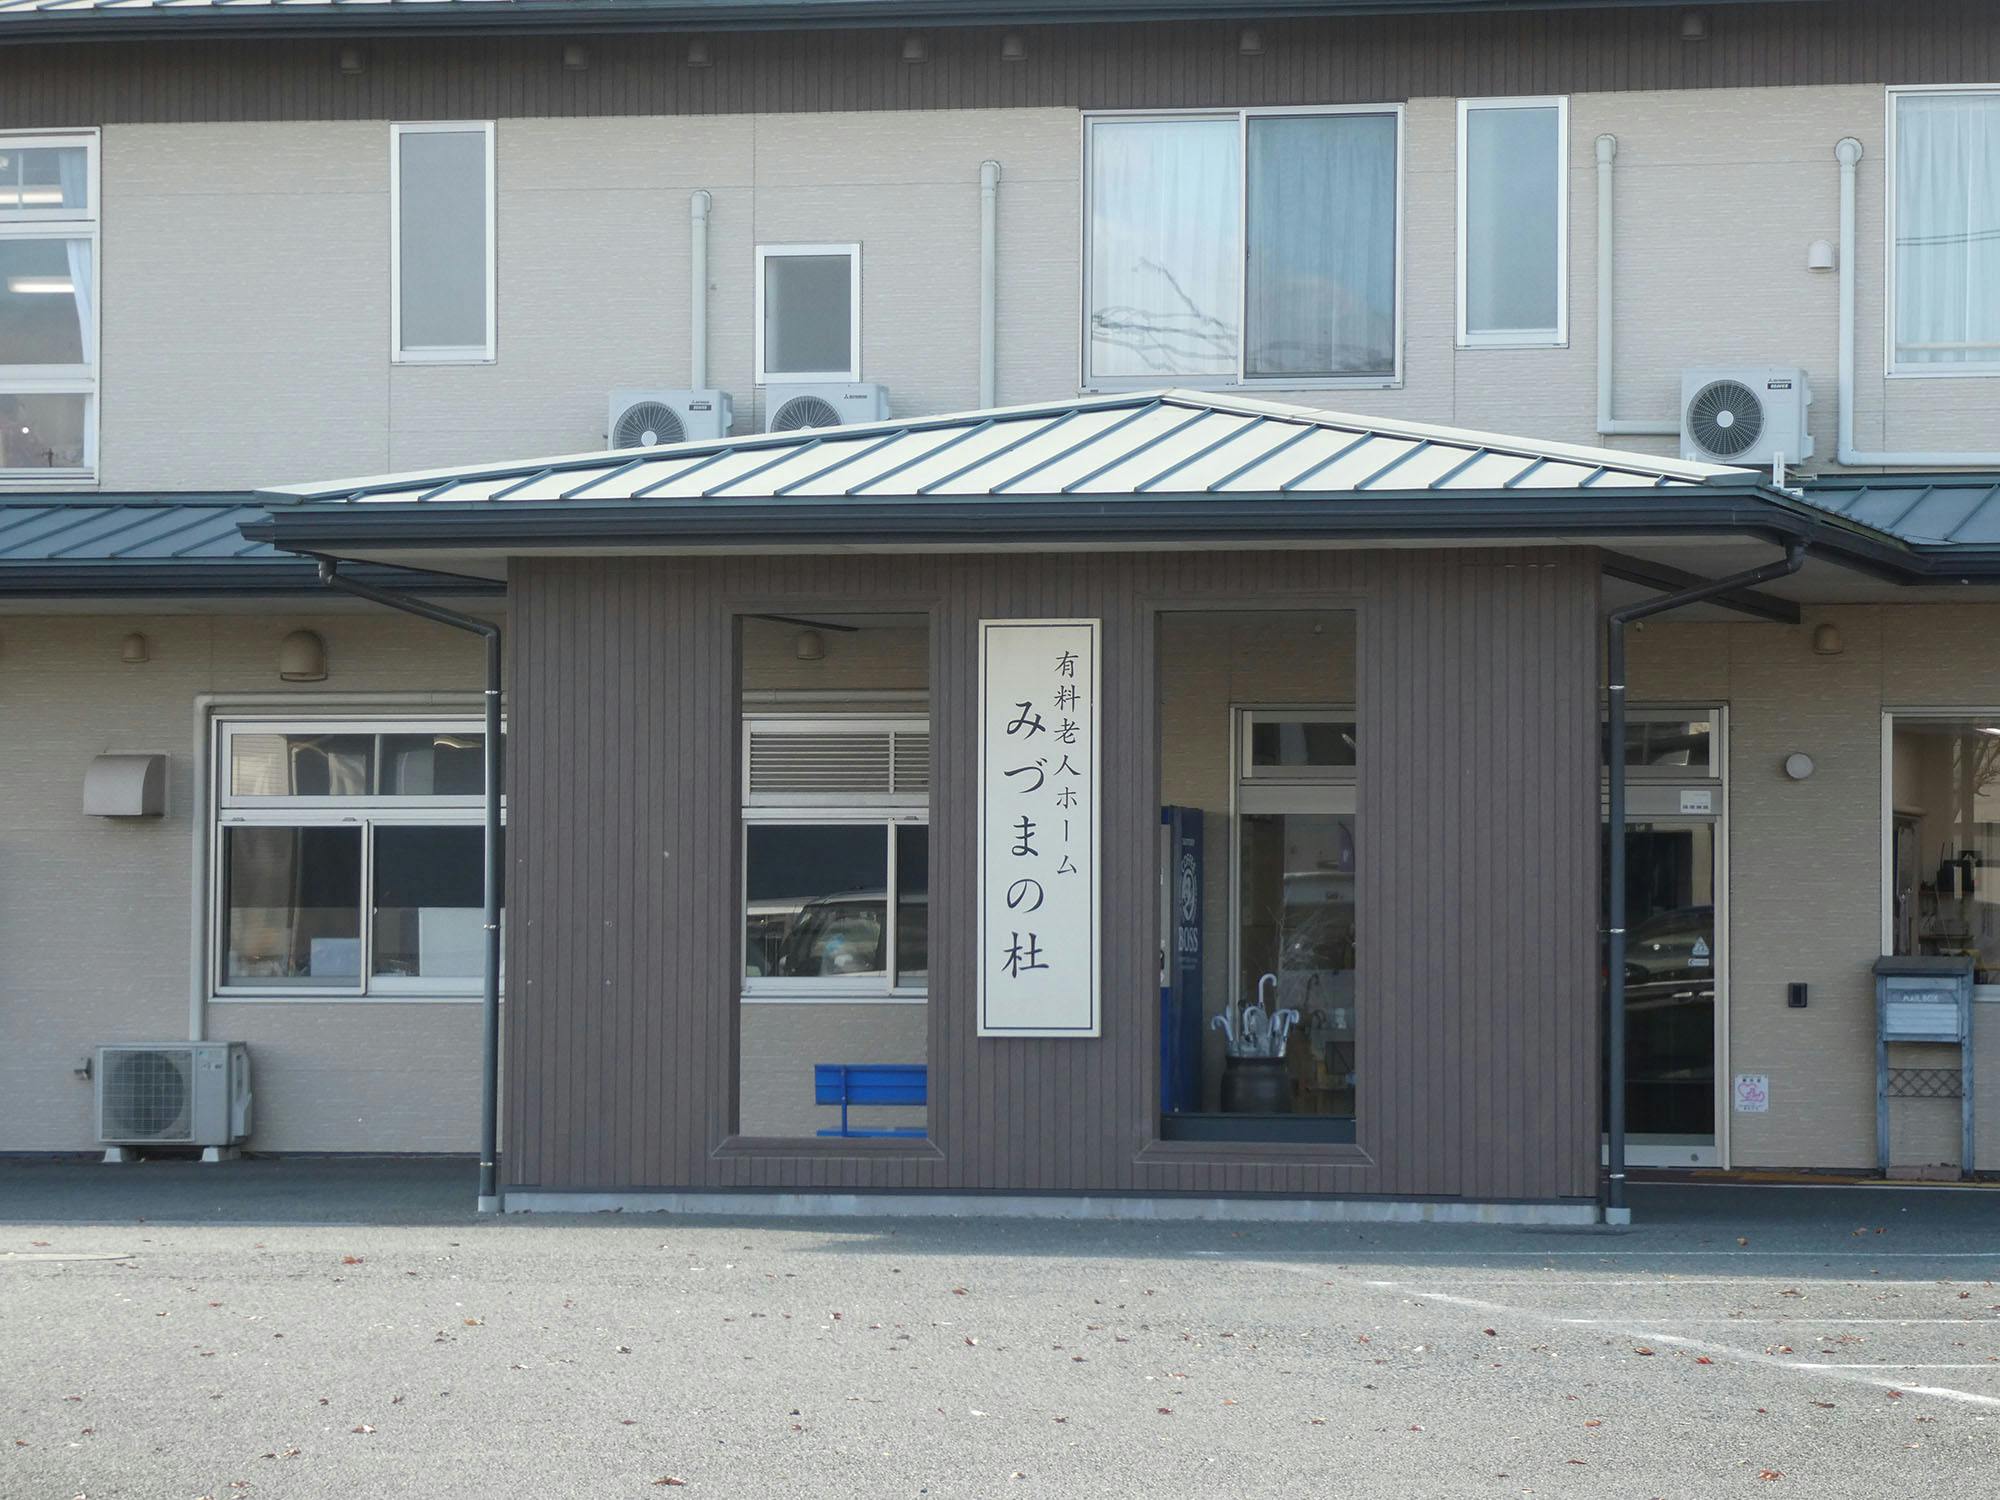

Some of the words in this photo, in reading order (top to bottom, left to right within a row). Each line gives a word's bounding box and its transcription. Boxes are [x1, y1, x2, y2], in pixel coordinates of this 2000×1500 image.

[1001, 701, 1050, 979] みづまの杜
[1053, 650, 1081, 875] 有料老人ホーム
[1178, 926, 1198, 952] BOSS
